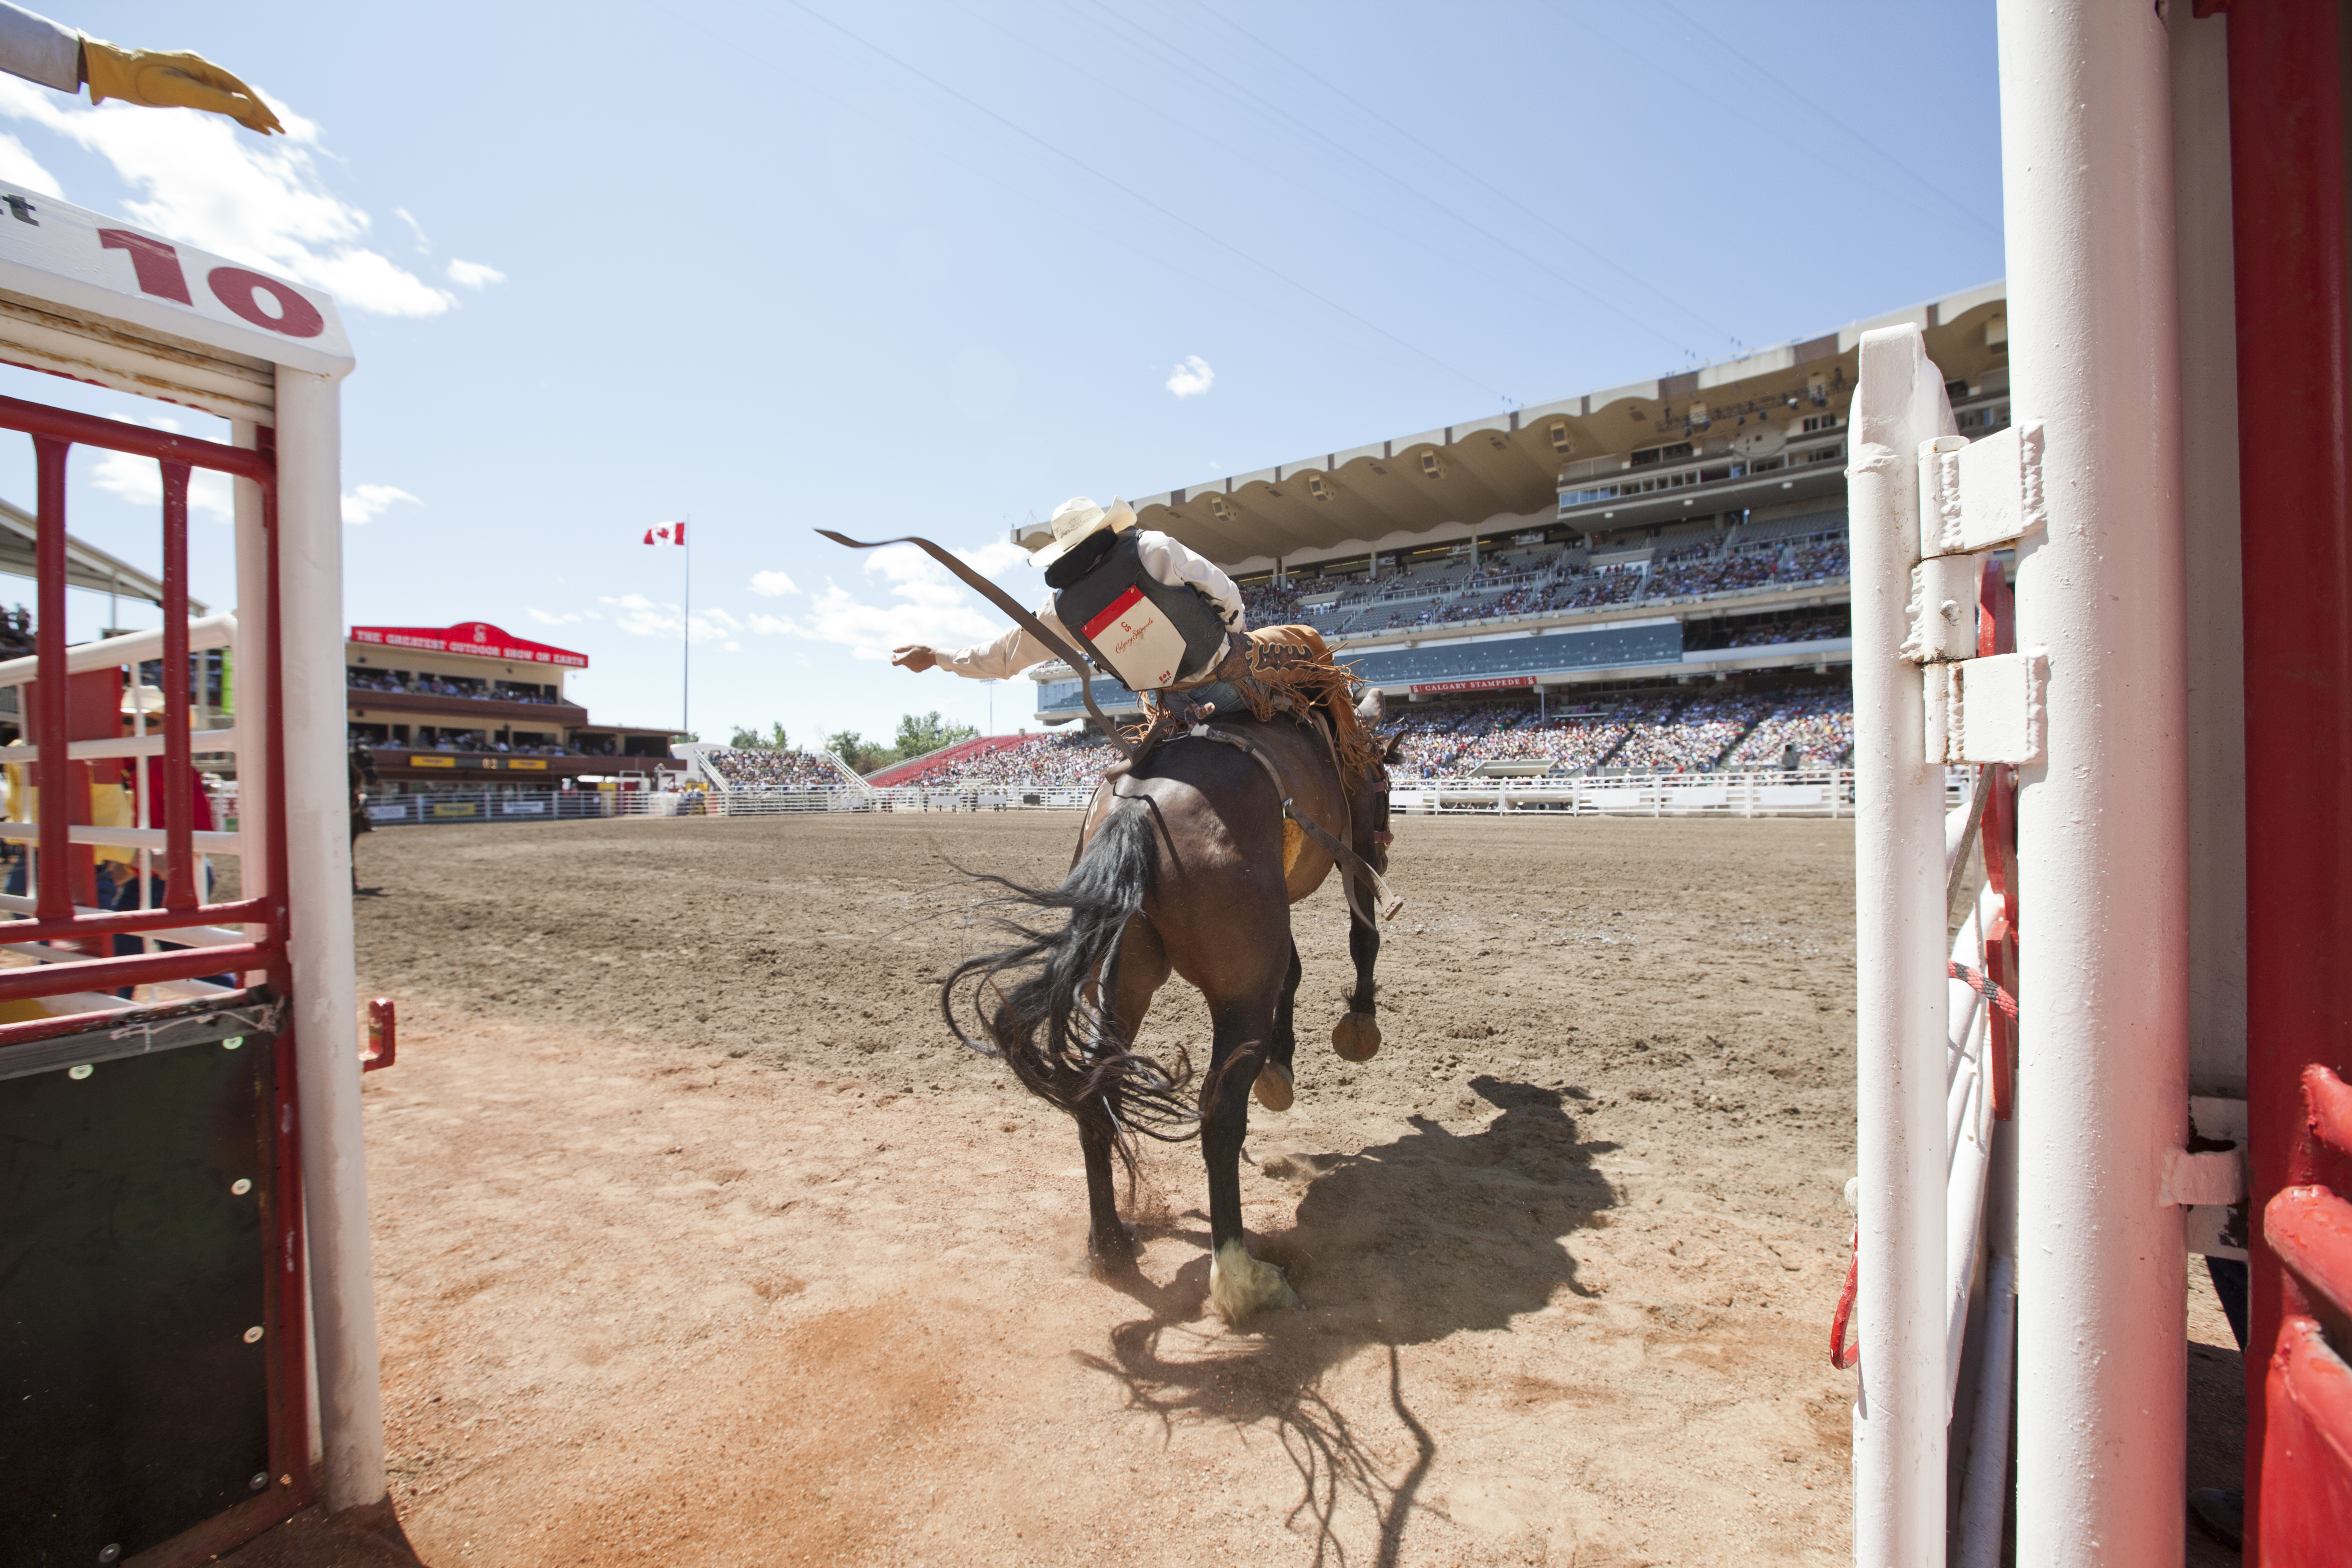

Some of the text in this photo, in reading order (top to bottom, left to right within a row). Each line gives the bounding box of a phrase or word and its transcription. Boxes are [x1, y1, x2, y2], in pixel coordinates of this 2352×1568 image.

[97, 227, 324, 338] 10
[356, 630, 585, 666] THE GREATEST OUTDOOR SHOW ON EARTH
[1115, 617, 1153, 654] Calgary Stampede
[1162, 676, 1172, 684] 2011
[1425, 682, 1466, 691] CALGARY
[1470, 679, 1521, 688] STAMPEDE
